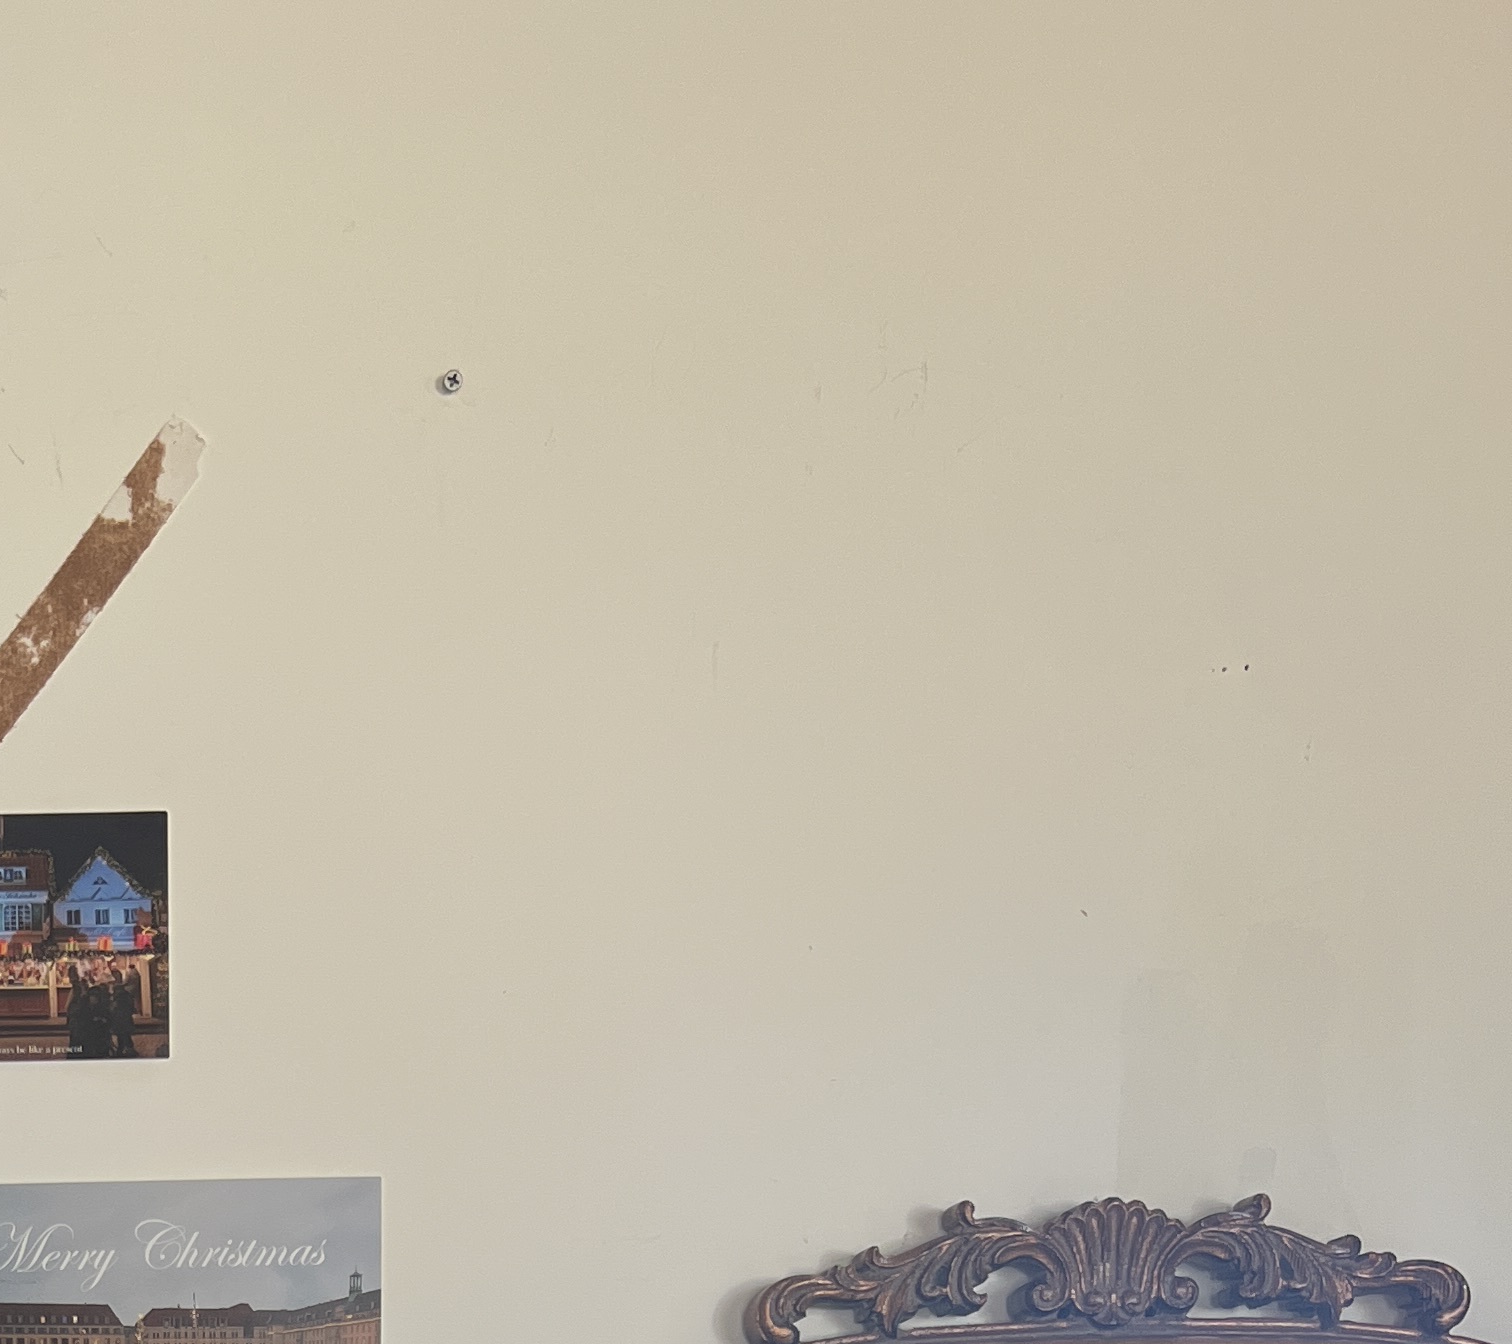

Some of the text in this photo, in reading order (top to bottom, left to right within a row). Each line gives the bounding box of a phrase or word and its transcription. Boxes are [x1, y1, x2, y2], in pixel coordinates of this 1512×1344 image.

[17, 1046, 25, 1055] be
[29, 1046, 41, 1055] like
[46, 1046, 50, 1055] a
[134, 1219, 328, 1270] Christmas
